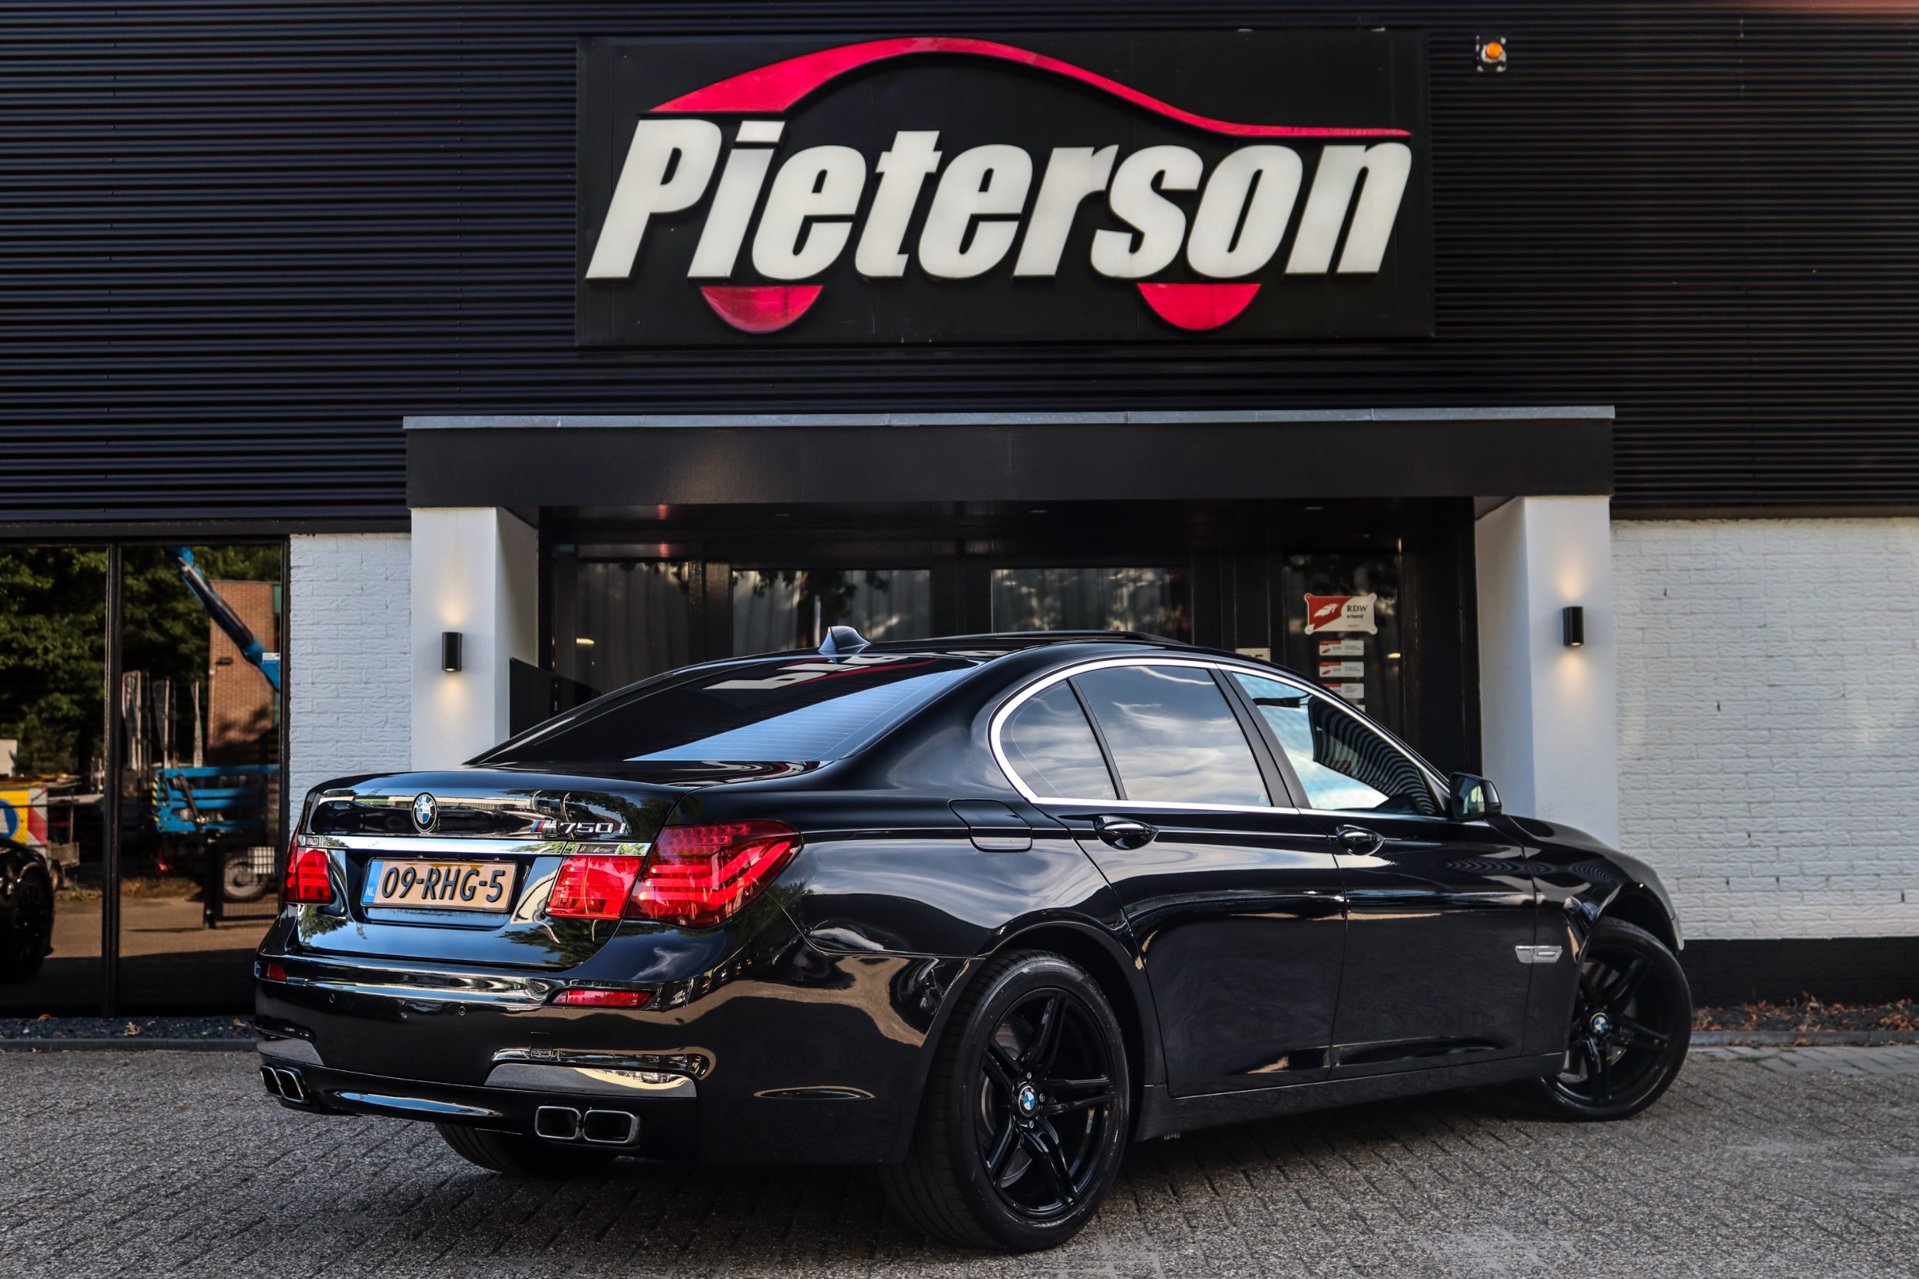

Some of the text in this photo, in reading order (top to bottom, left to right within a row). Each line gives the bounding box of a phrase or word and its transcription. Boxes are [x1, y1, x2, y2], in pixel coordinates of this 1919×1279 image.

[586, 119, 1412, 281] Pieterson
[1346, 604, 1368, 612] RDW
[365, 887, 375, 897] NL
[382, 867, 506, 903] 09-RHG-5
